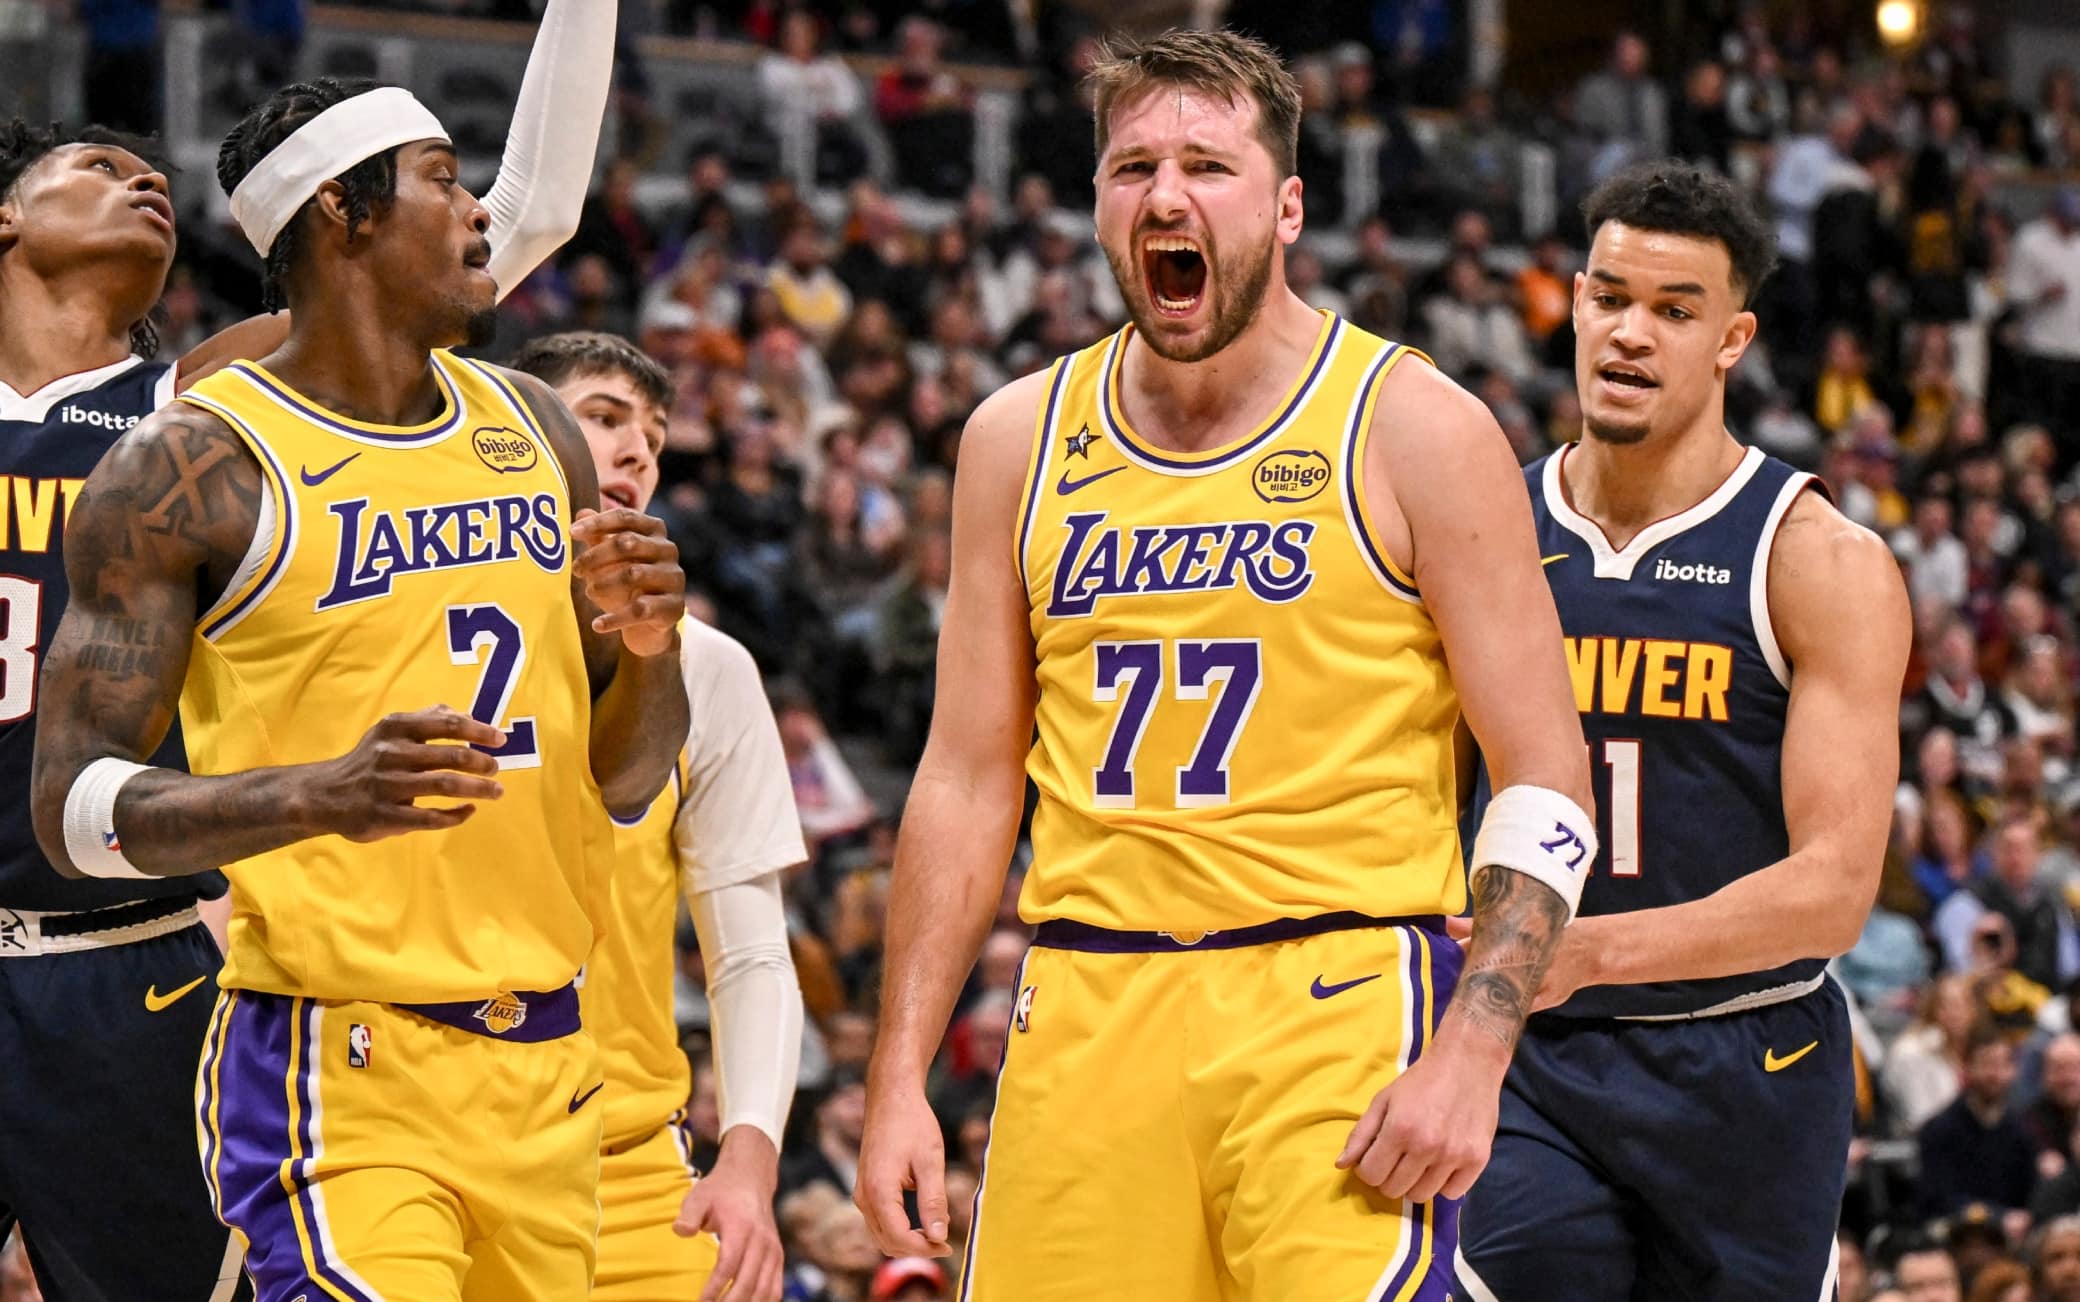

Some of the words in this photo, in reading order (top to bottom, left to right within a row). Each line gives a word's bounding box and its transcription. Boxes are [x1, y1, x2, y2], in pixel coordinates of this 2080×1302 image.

[62, 405, 139, 430] ibotta
[477, 437, 531, 457] bibigo
[1260, 464, 1327, 487] bibigo
[1270, 483, 1298, 491] 비비고
[314, 493, 566, 613] LAKERS
[1046, 511, 1317, 617] LAKERS
[1655, 560, 1731, 585] ibotta
[446, 602, 542, 771] 2
[1092, 638, 1263, 809] 77
[1539, 821, 1587, 873] 77
